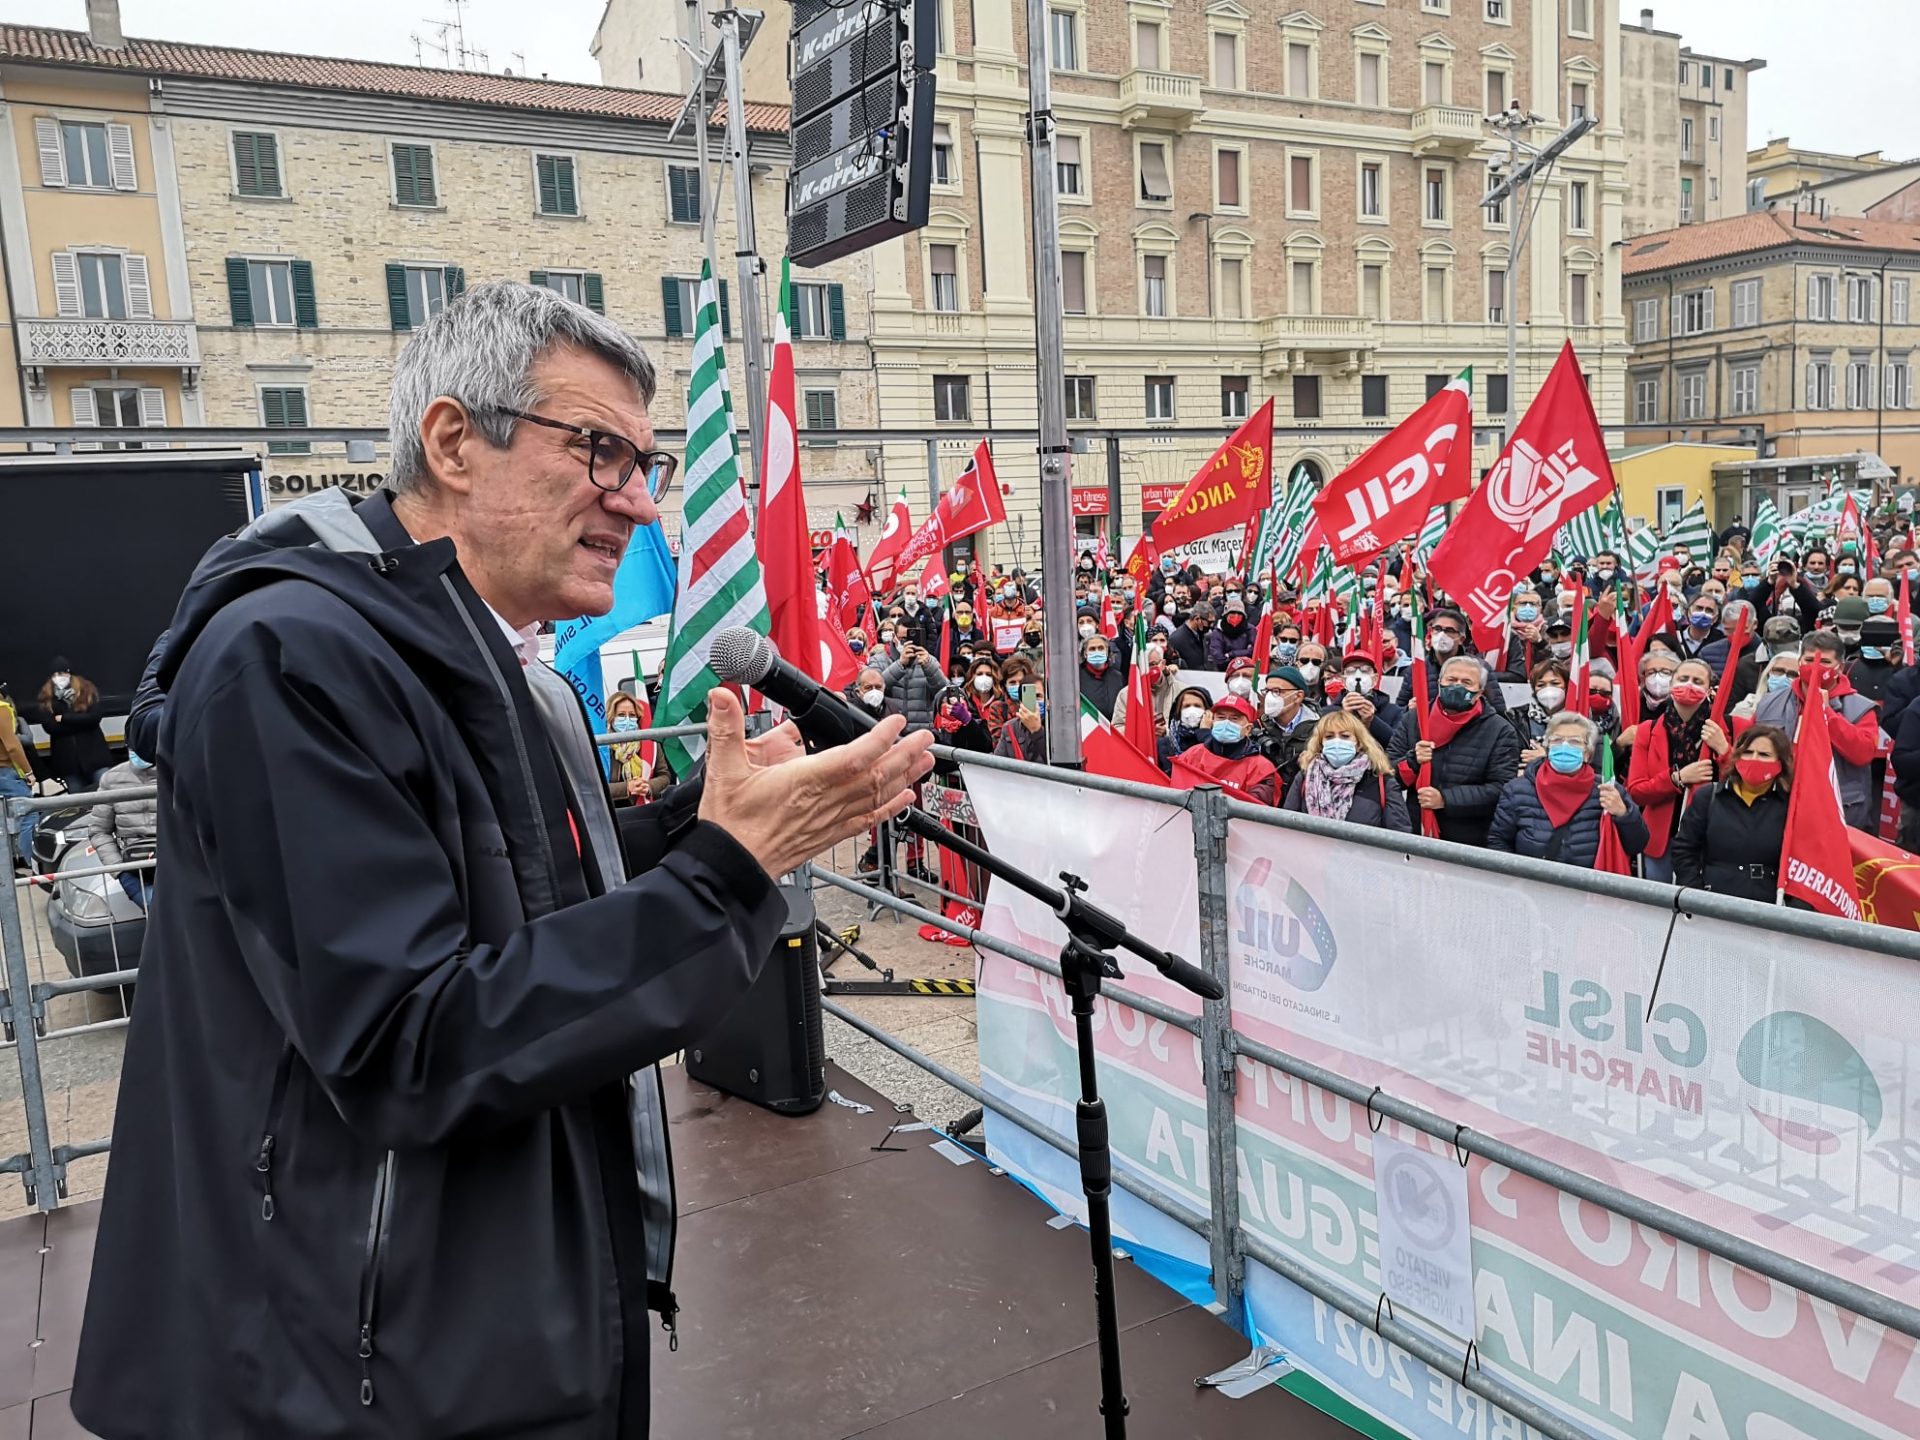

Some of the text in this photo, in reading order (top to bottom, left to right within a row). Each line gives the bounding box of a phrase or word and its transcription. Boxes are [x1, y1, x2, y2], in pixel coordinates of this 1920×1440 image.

[268, 473, 388, 494] SOLUZIO
[1083, 491, 1106, 502] fitness
[1143, 488, 1163, 499] urban
[1183, 540, 1208, 556] CGIL
[1788, 857, 1860, 920] EDERAZIONE
